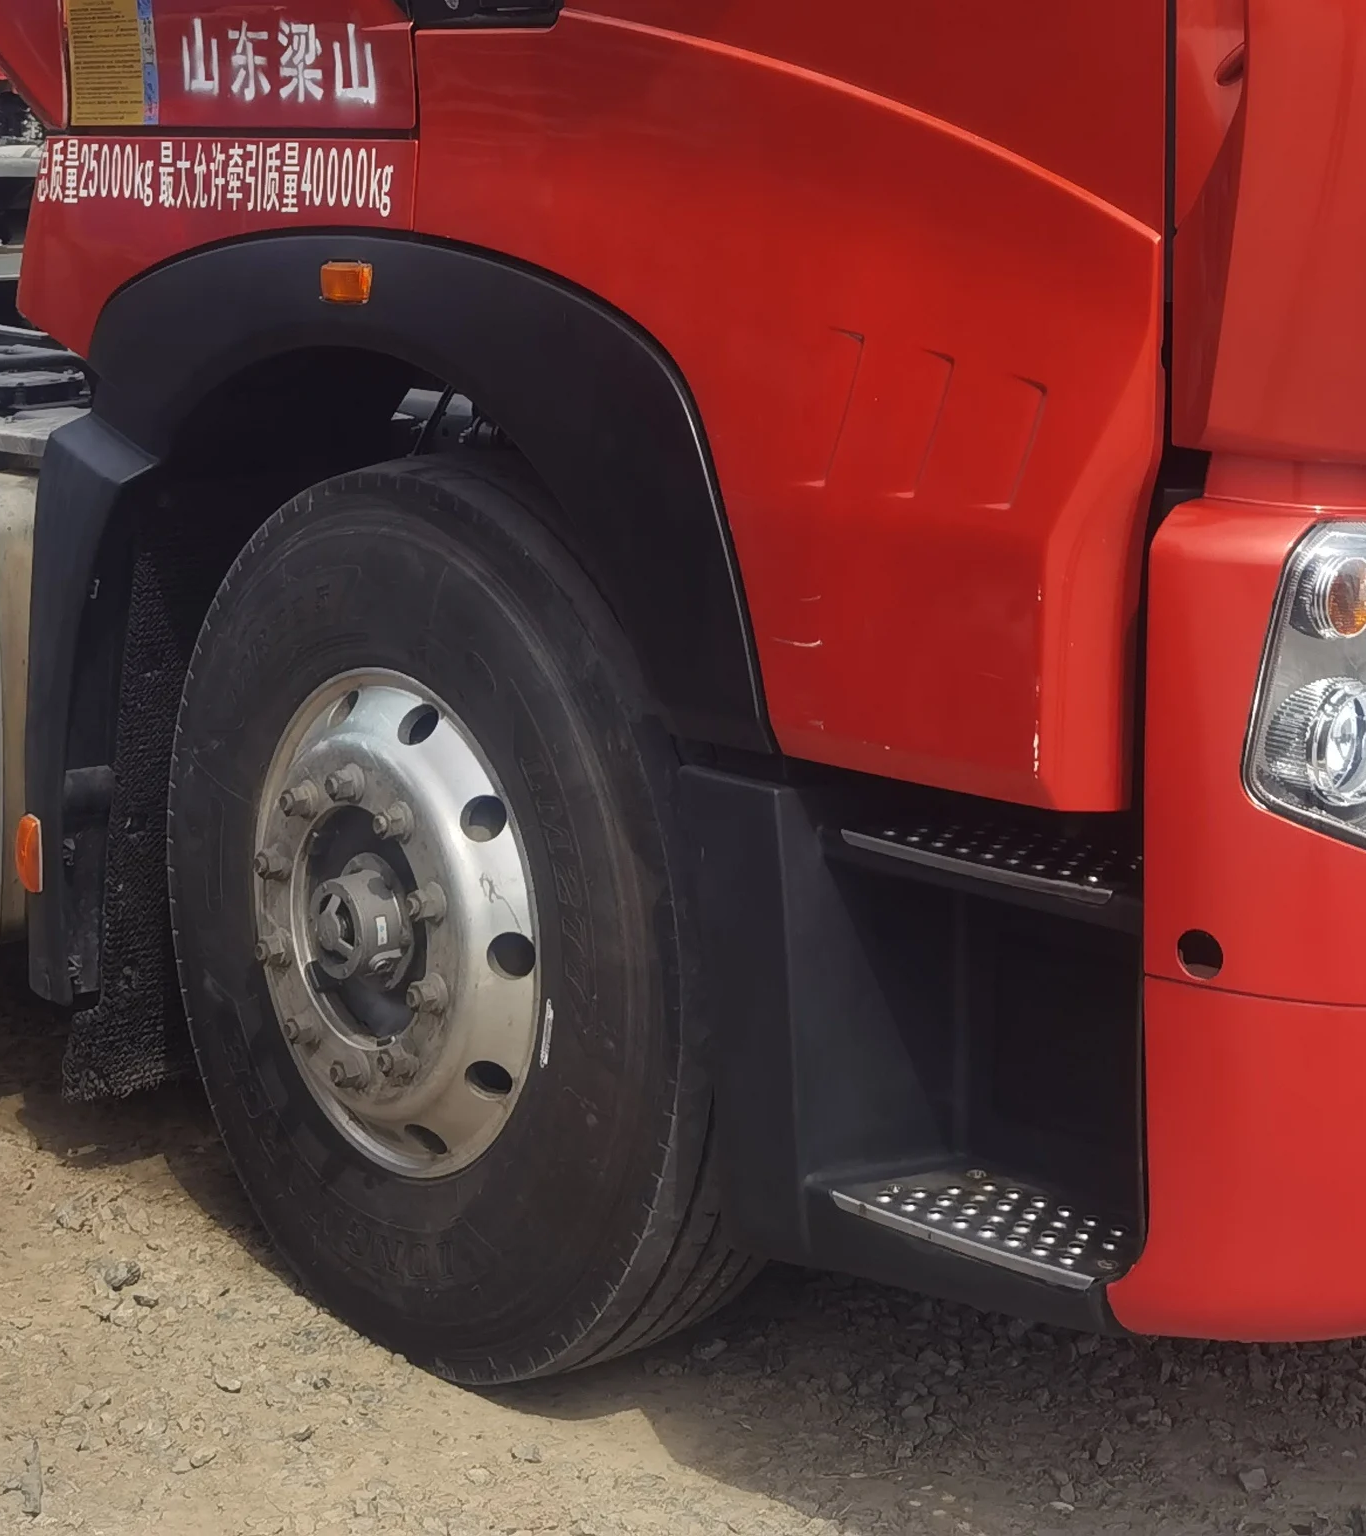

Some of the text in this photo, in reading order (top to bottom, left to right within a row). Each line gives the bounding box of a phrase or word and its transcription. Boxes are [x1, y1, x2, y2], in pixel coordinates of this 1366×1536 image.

[181, 17, 378, 106] 山东梁山
[158, 141, 395, 218] 最大允许牵引质量40000kg
